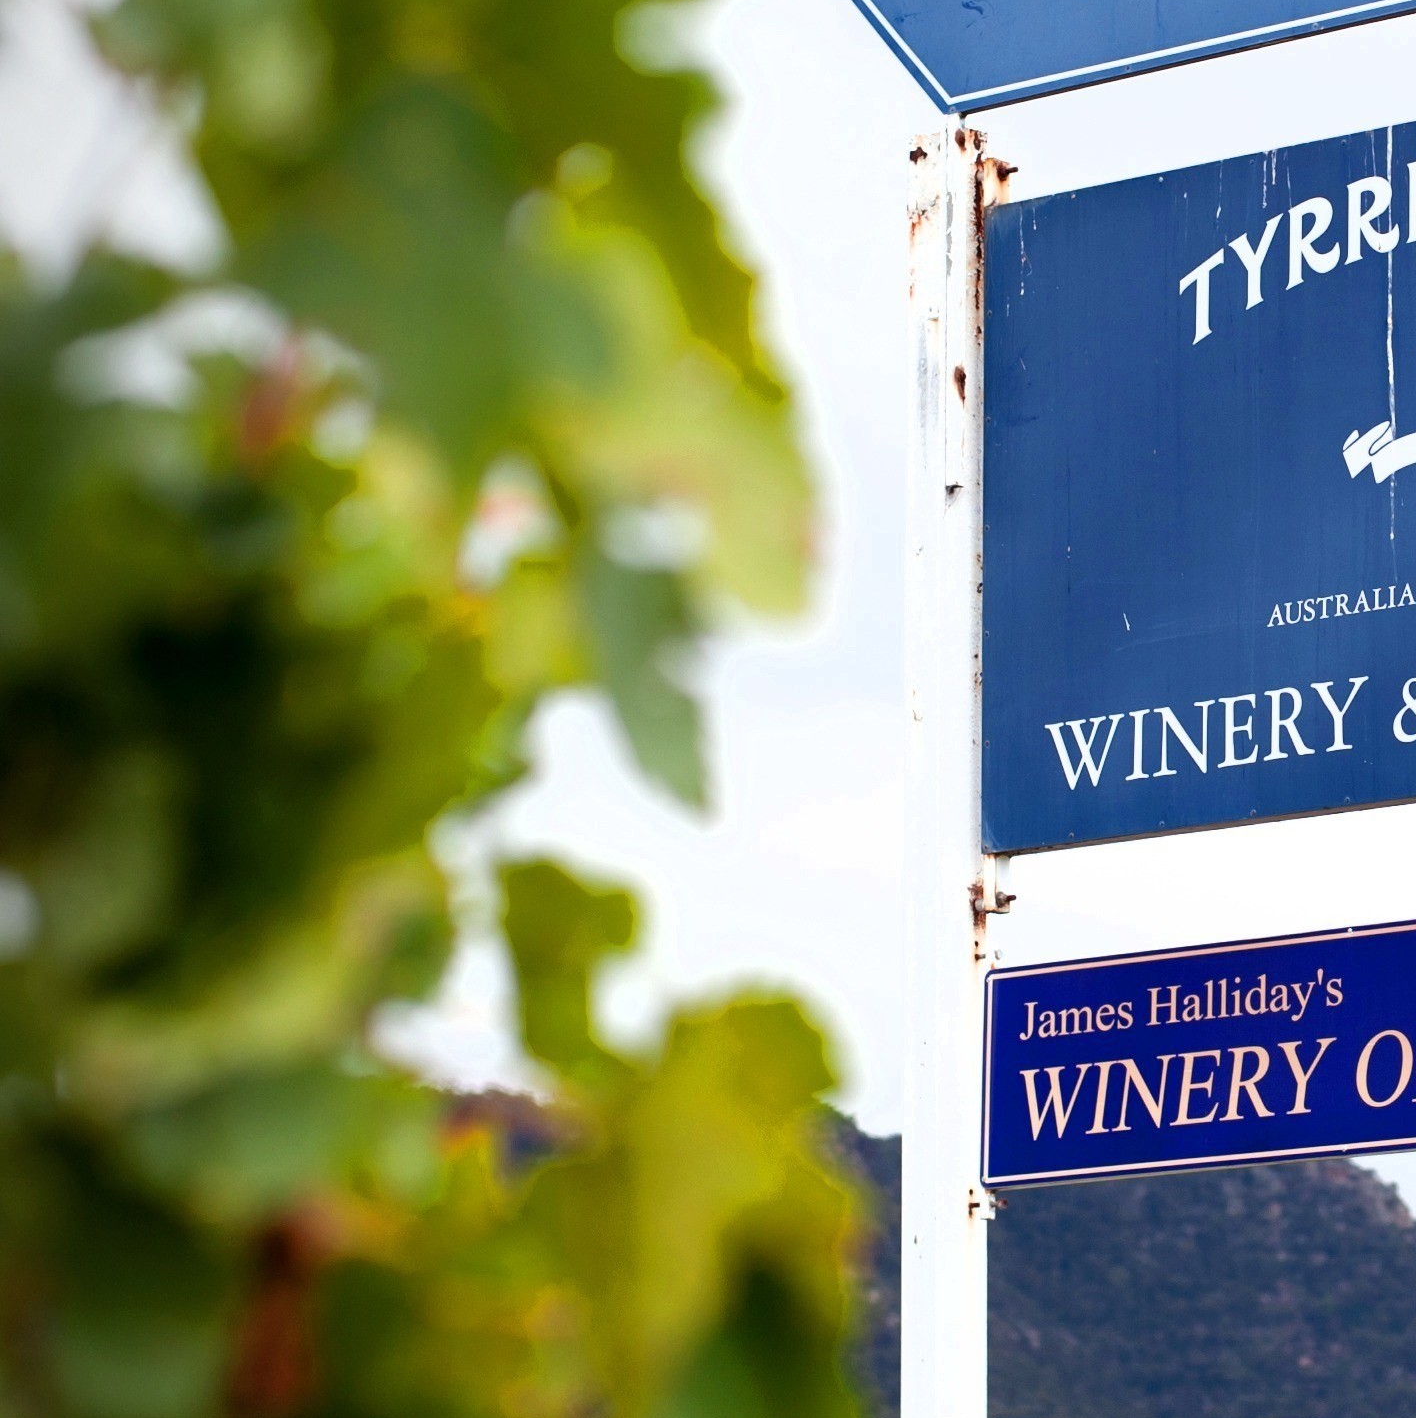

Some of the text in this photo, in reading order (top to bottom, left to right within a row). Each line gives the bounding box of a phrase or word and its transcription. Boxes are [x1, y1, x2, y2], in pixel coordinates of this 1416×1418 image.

[1045, 677, 1368, 791] WINERY
[1019, 968, 1344, 1042] James Halliday's
[1019, 1037, 1338, 1143] WINERY
